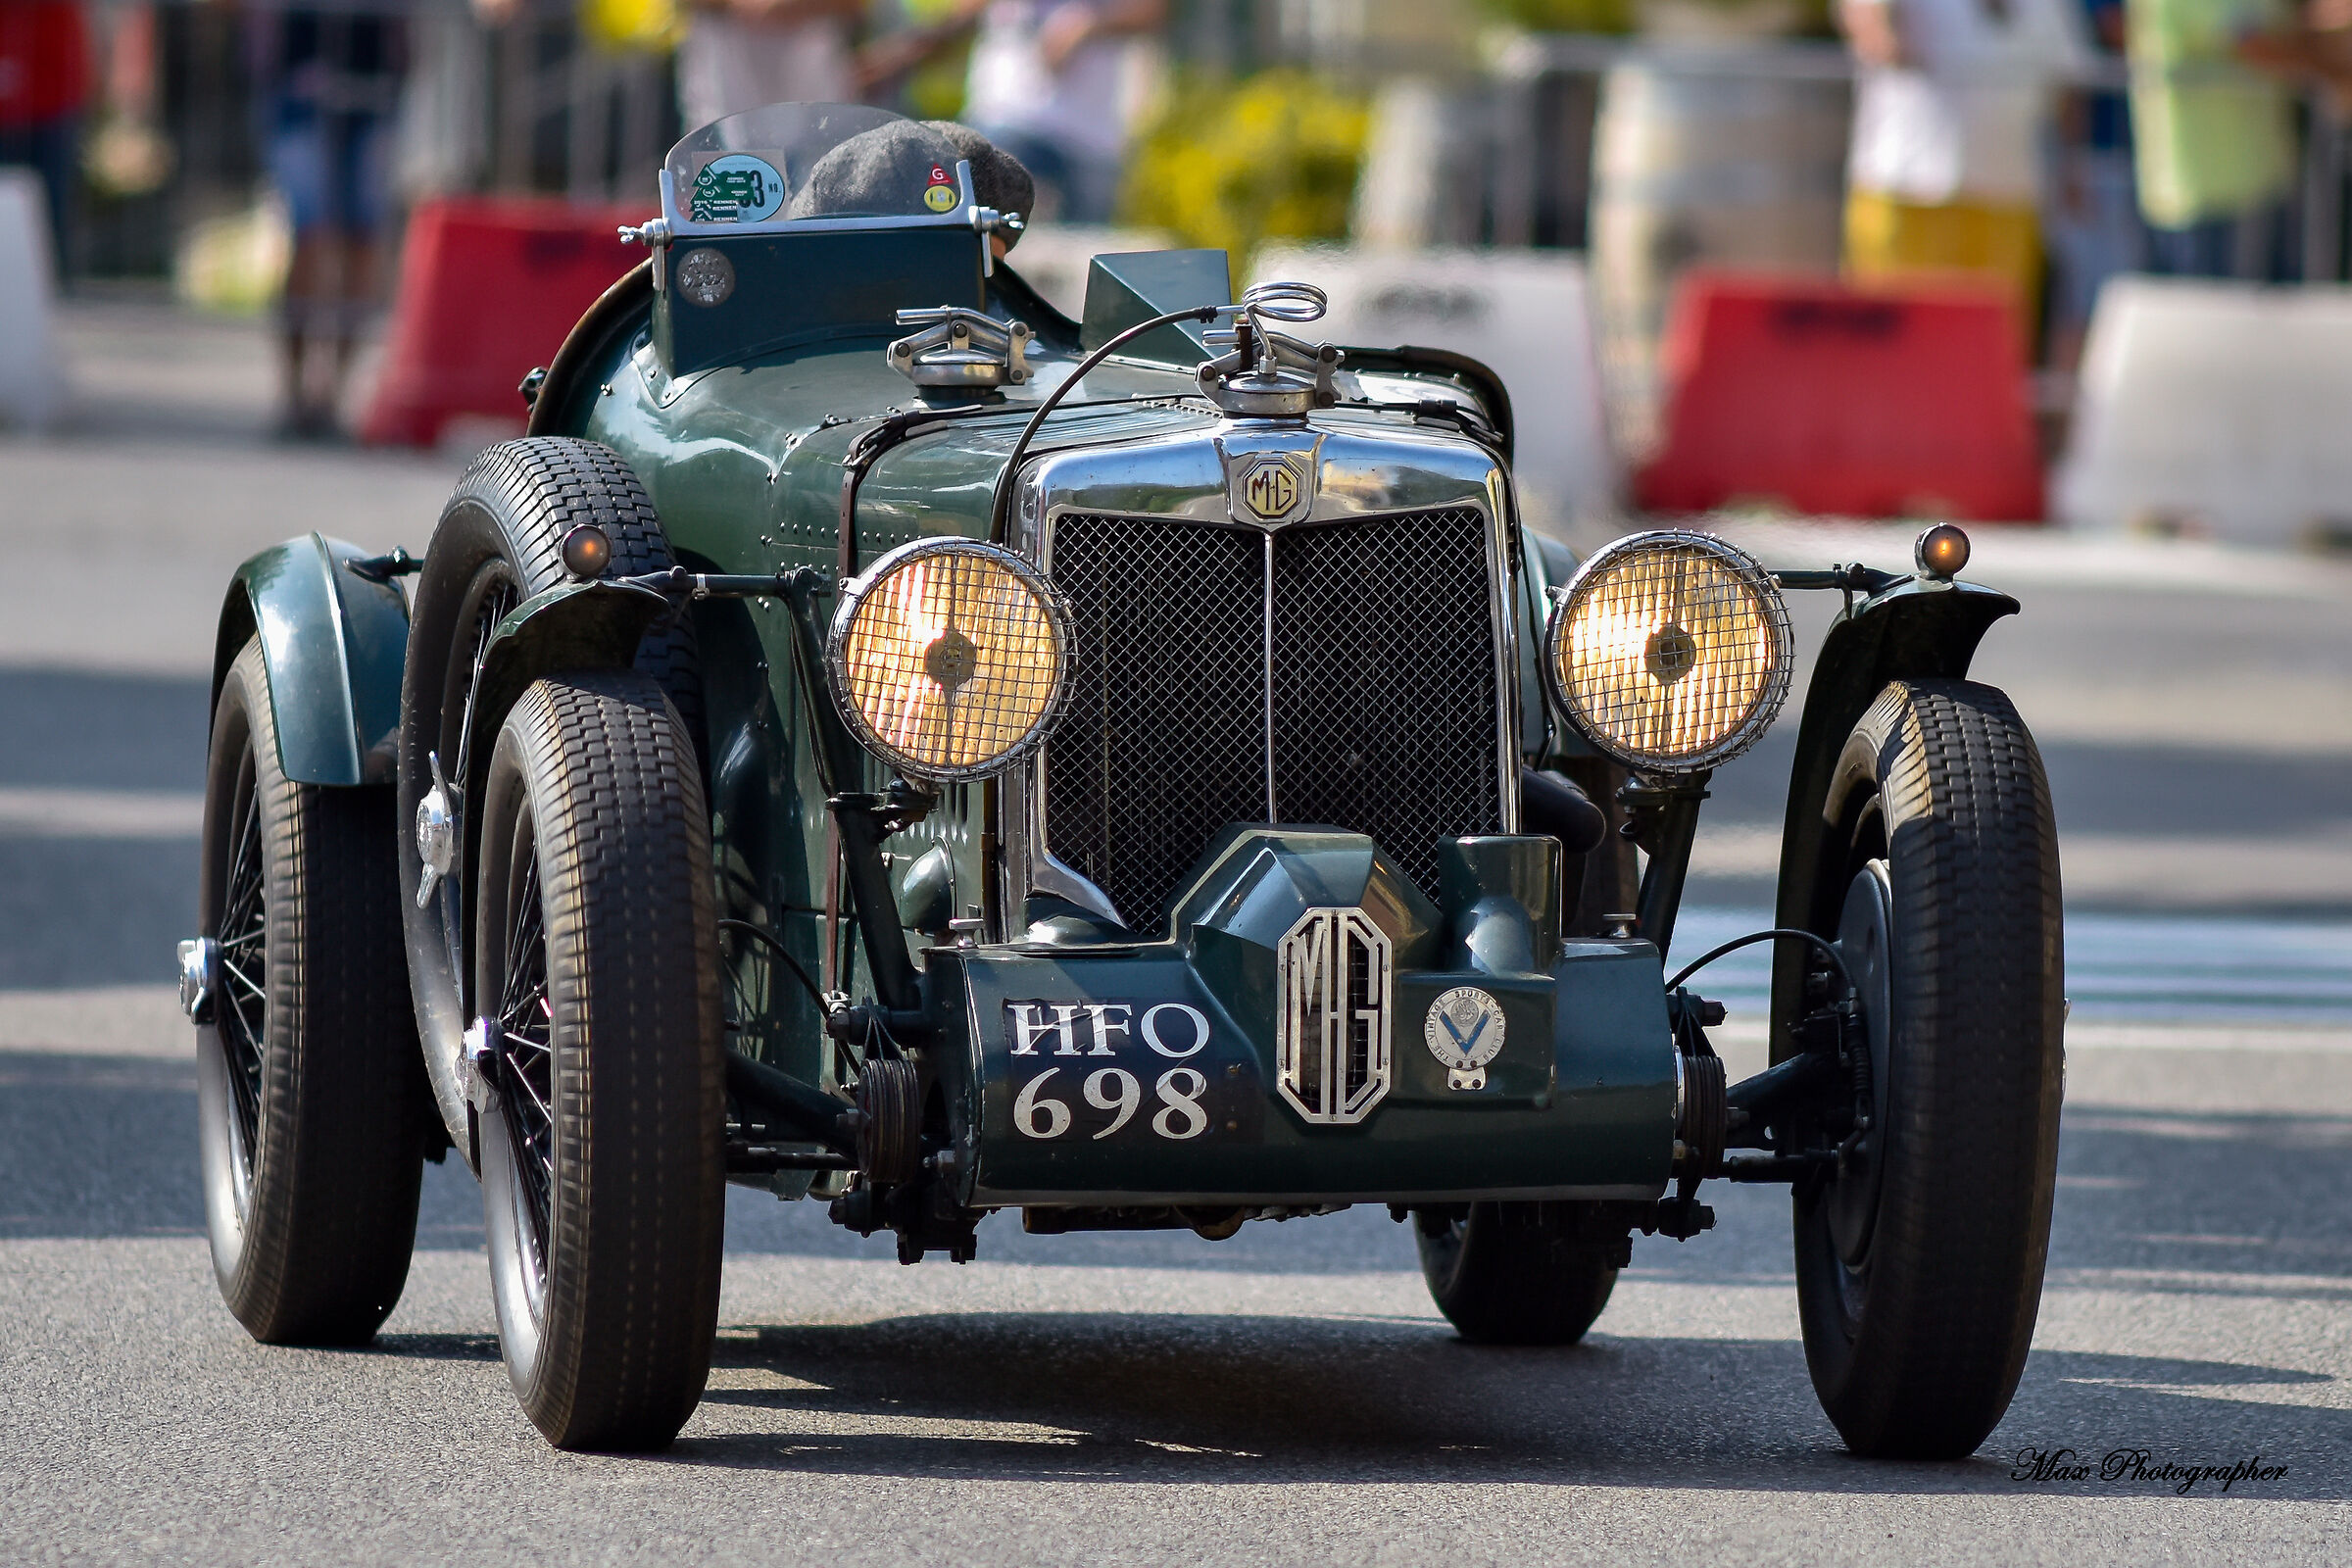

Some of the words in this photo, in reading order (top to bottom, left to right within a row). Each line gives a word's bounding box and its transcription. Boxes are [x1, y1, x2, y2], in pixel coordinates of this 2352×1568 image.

[931, 168, 944, 180] G
[1006, 1003, 1210, 1058] HFO
[1013, 1067, 1207, 1141] 698
